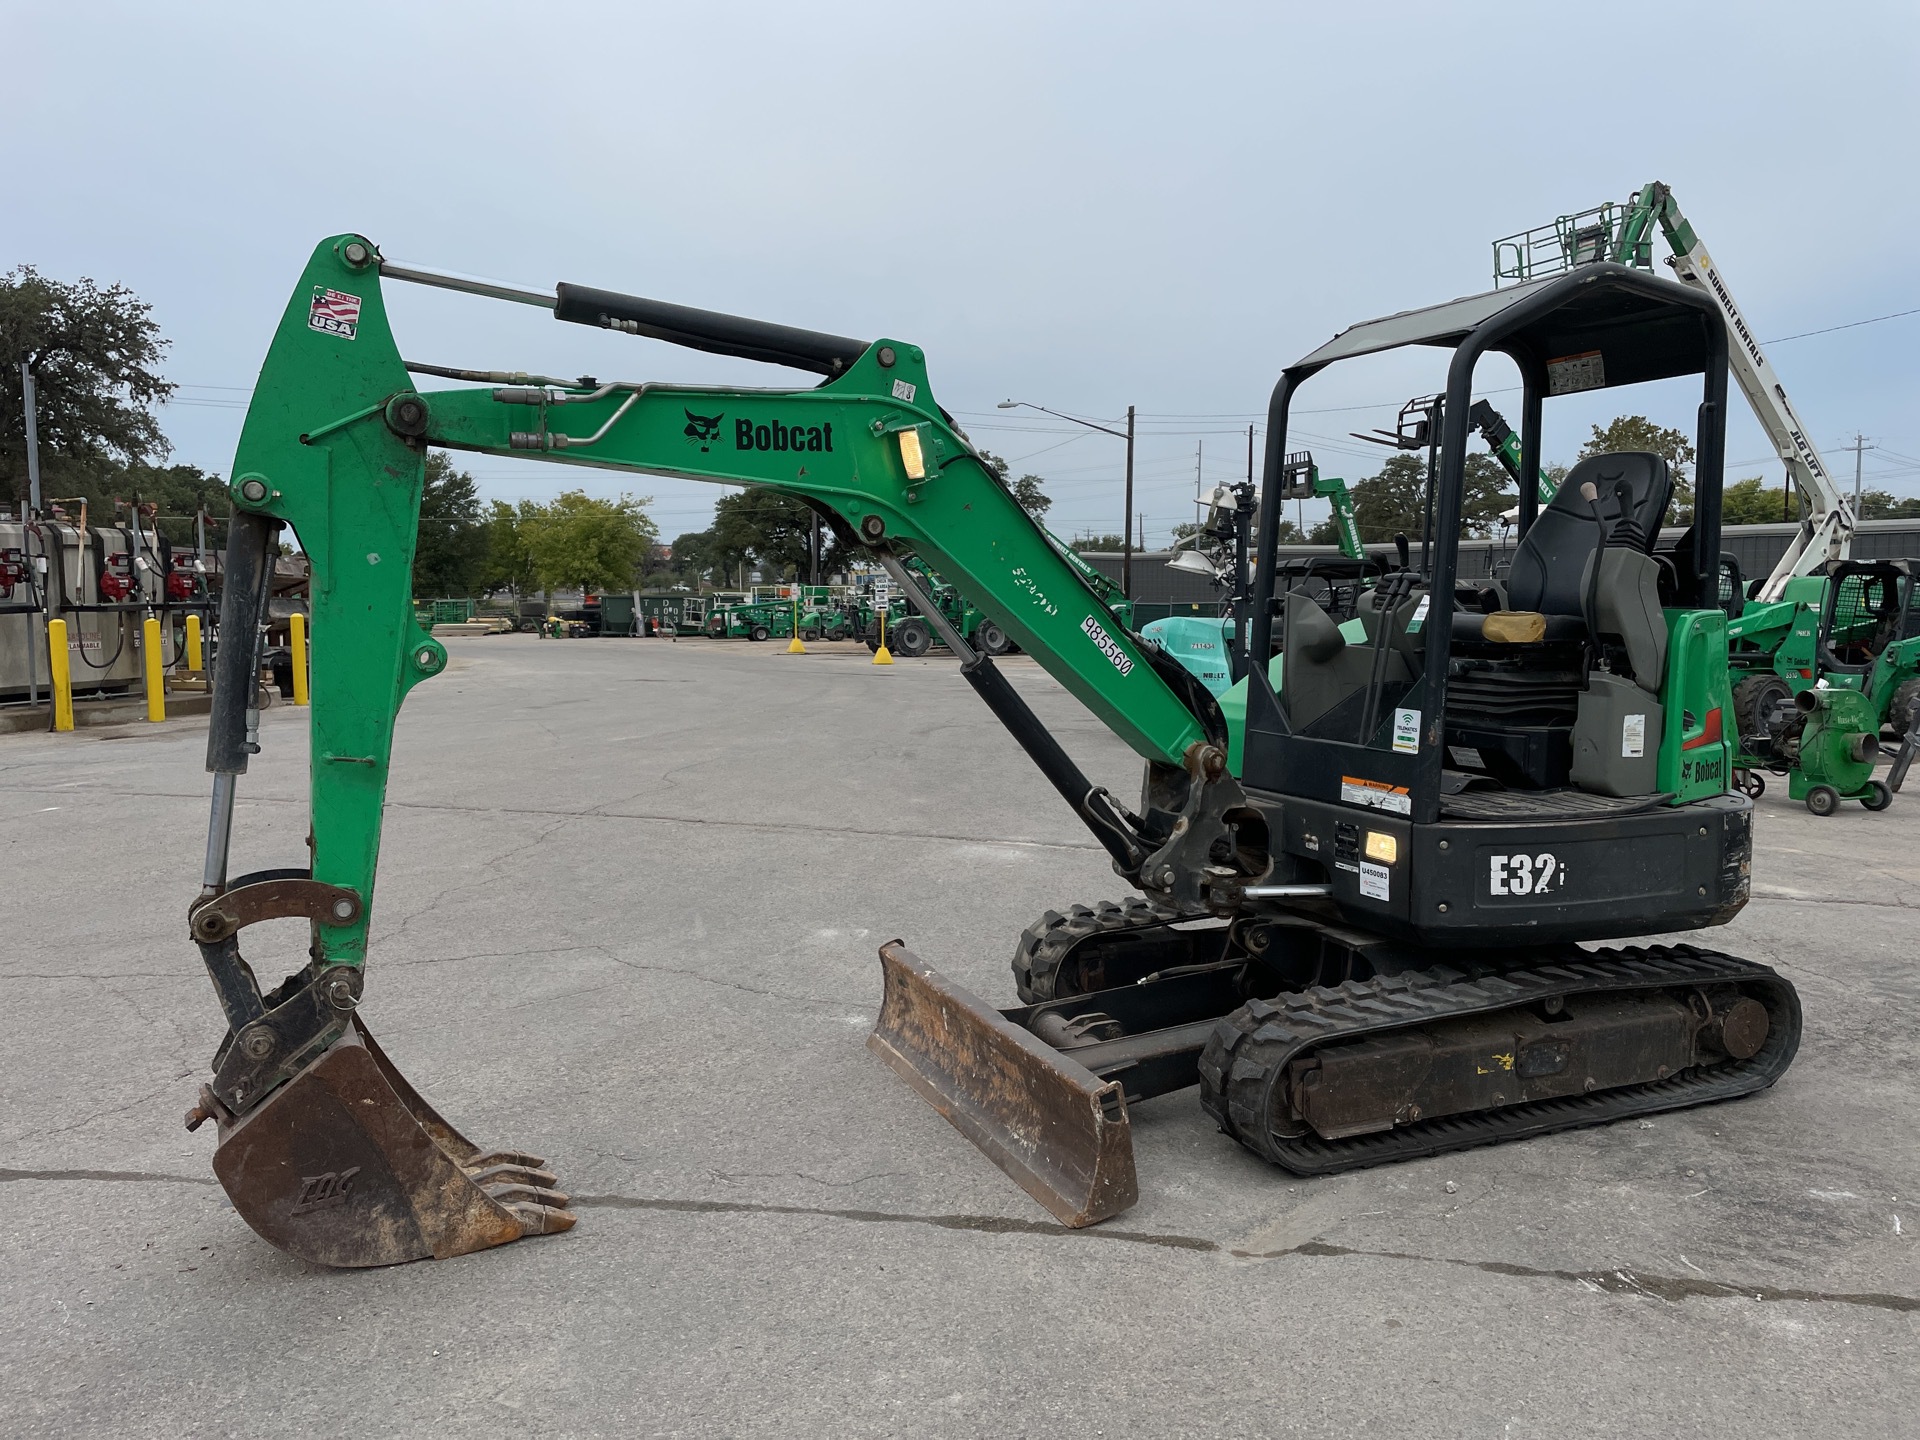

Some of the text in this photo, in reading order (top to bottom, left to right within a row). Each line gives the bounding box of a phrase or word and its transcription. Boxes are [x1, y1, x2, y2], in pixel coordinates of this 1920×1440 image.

[312, 316, 352, 335] USA
[1708, 268, 1764, 368] SUNBELT RENTALS
[735, 418, 833, 453] Bobcat
[1790, 429, 1823, 478] JLG LIFT
[1347, 518, 1361, 553] SUNBELT
[1068, 552, 1092, 574] RENTALS
[69, 642, 100, 650] FLAABLE
[1085, 616, 1134, 675] 985560
[1397, 725, 1418, 733] TELEMATICS
[1695, 757, 1722, 783] Bobcat
[1361, 867, 1388, 880] U450083
